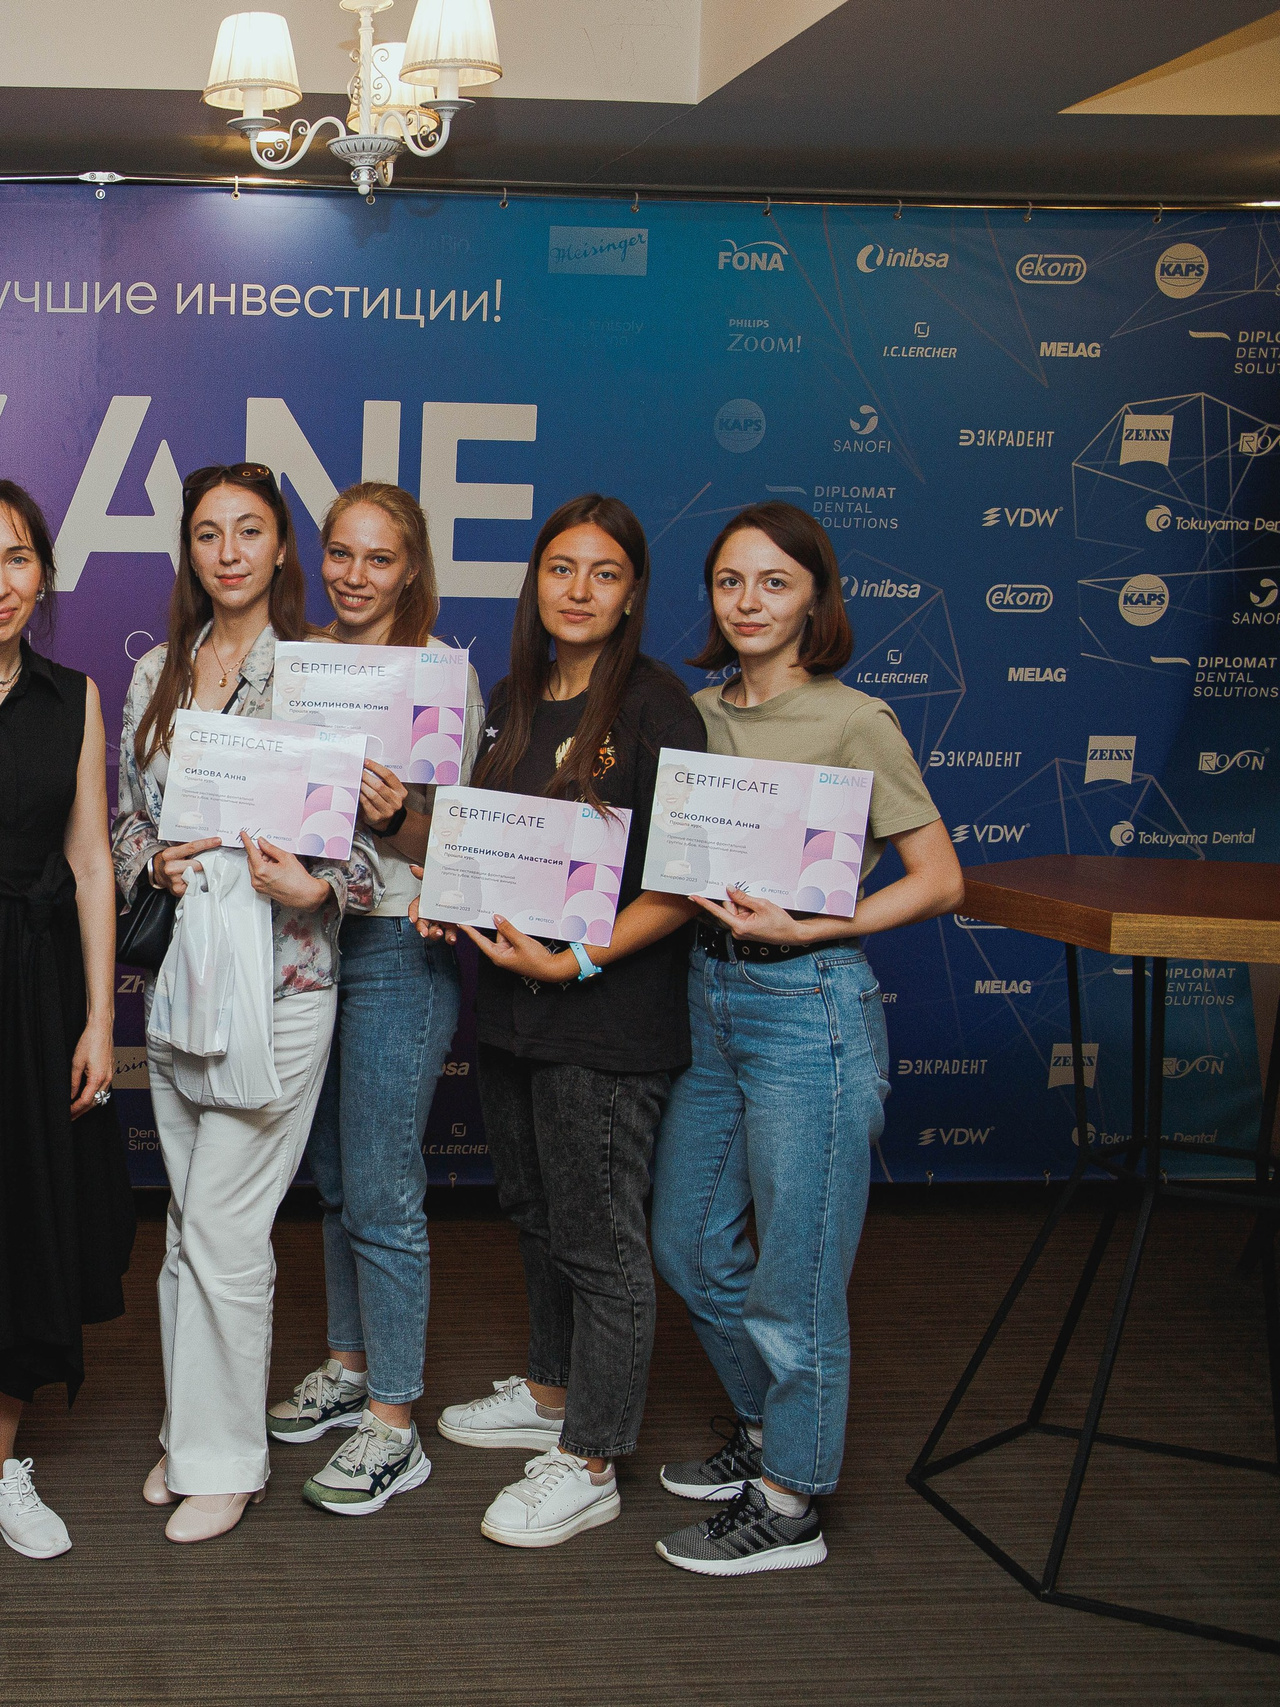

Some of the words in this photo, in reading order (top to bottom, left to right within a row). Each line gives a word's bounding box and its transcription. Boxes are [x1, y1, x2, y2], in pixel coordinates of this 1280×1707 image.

[718, 250, 785, 272] FONA
[886, 248, 950, 269] inibsa
[1021, 256, 1082, 277] ekom
[1159, 261, 1205, 278] KAPS
[176, 279, 502, 329] инвестиции!
[728, 318, 770, 329] PHILIPS
[1238, 331, 1280, 344] DIPLO
[883, 345, 958, 359] I.C.LERCHER
[1039, 342, 1102, 358] MELAG
[719, 418, 762, 433] KAPS
[977, 429, 1055, 448] ЭКРАДЕНТ
[1123, 428, 1172, 442] ZEISS
[833, 439, 892, 454] SANOFI
[814, 485, 897, 499] DIPLOMAT
[813, 501, 873, 514] DENTAL
[1004, 507, 1060, 528] VDW
[1176, 515, 1250, 534] Tokuyama
[860, 578, 921, 599] inibsa
[991, 586, 1049, 606] ekom
[1122, 592, 1166, 607] KAPS
[1231, 611, 1280, 626] SANOF
[420, 652, 464, 665] DIZANE
[1197, 656, 1278, 670] DIPLOMAT
[290, 662, 386, 677] CERTIFICATE
[1007, 667, 1067, 683] MELAG
[1195, 671, 1255, 684] DENTAL
[856, 672, 929, 684] I.C.LERCHER
[1193, 685, 1280, 698] SOLUTIONS
[288, 700, 362, 710] СУХОМЛИНОВА
[364, 703, 389, 711] Юлия
[189, 730, 284, 753] CERTIFICATE
[946, 751, 1022, 768] ЭКРАДЕНТ
[1088, 749, 1134, 761] ZEISS
[184, 767, 222, 778] СИЗОВА
[224, 772, 247, 782] Анна
[818, 772, 868, 788] DIZANE
[674, 771, 779, 796] CERTIFICATE
[449, 805, 546, 829] CERTIFICATE
[669, 811, 733, 826] ОСКОЛКОВА
[735, 819, 761, 830] Анна
[973, 825, 1027, 843] VDW
[1138, 831, 1208, 848] Tokuyama
[1212, 827, 1256, 845] Dental
[444, 843, 516, 860] ПОТРЕБНИКОВА
[517, 853, 564, 866] Анастасия
[974, 979, 1032, 995] MELAG
[1167, 982, 1212, 993] ENTAL
[1164, 995, 1235, 1006] OLUTIONS
[914, 1059, 988, 1076] ЭКРАДЕНТ
[938, 1127, 991, 1146] VDW
